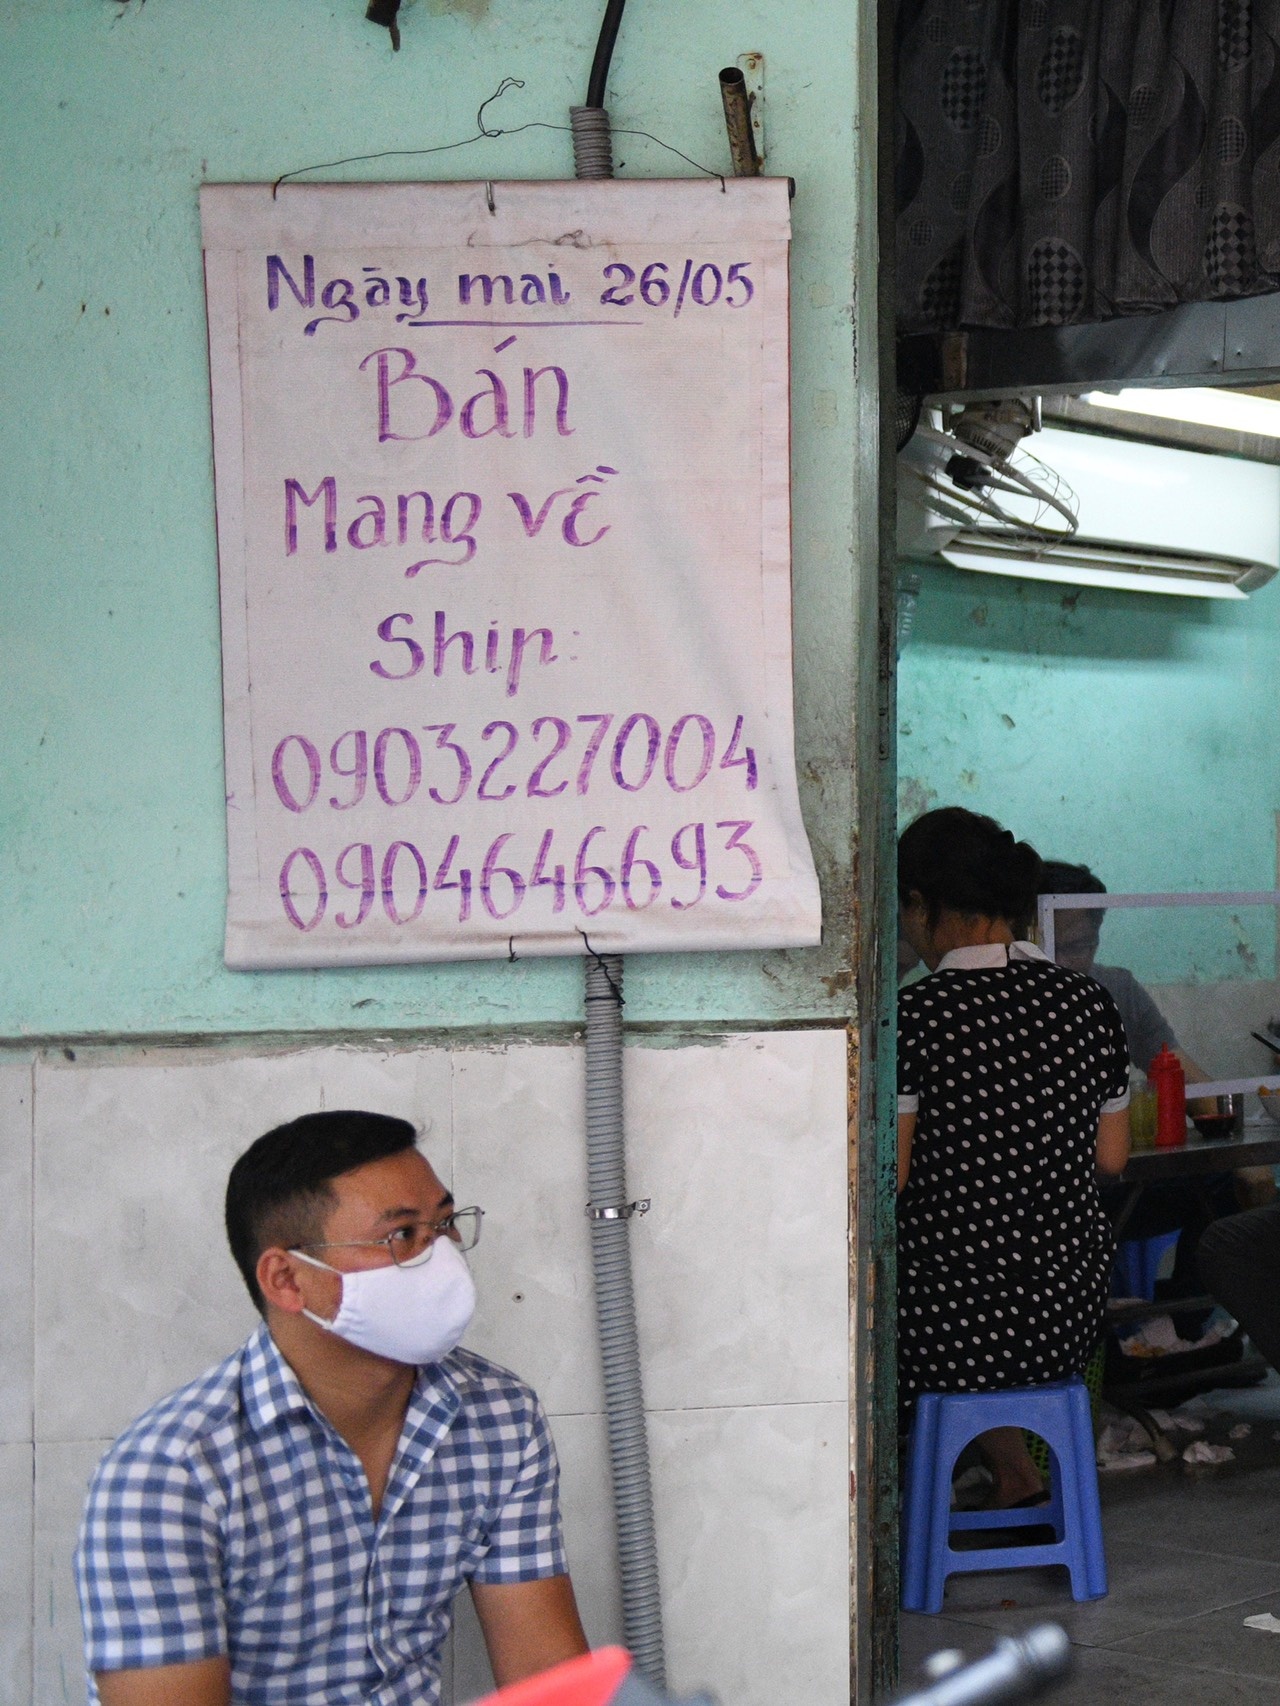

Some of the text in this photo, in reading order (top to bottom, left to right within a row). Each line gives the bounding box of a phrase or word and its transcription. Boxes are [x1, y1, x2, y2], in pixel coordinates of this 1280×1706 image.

[458, 262, 571, 307] mai
[600, 258, 755, 319] 26/05
[359, 335, 576, 443] Bán
[284, 465, 620, 579] Mang về
[271, 713, 760, 814] 0903227004
[279, 821, 763, 933] 0904646693
